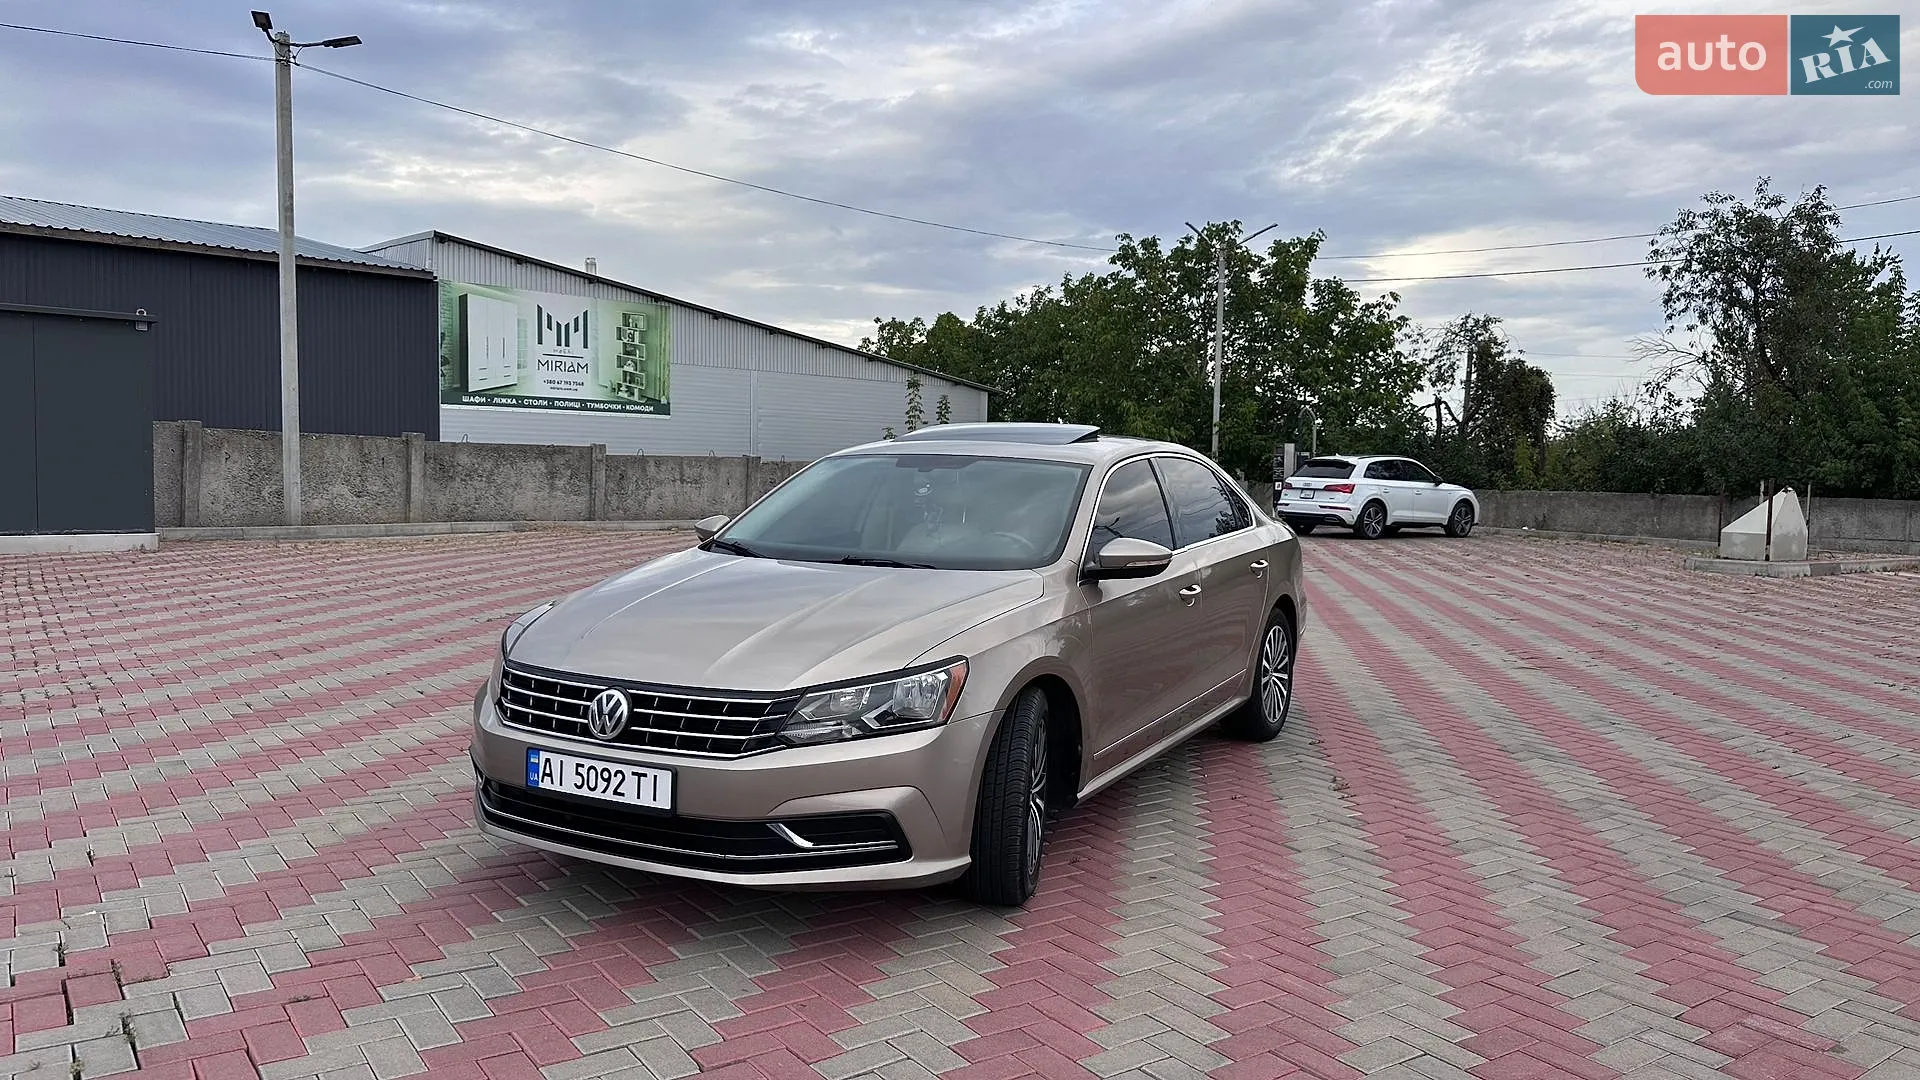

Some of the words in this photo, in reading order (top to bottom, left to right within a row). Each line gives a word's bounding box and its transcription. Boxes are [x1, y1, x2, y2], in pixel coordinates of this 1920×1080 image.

[462, 395, 486, 404] ШАФИ
[493, 397, 518, 405] ЛІЖКА
[523, 398, 548, 407] СТОЛИ
[554, 400, 581, 409] ПОЛИЦІ
[586, 402, 621, 411] ТУМБОЧКИ
[625, 404, 654, 412] КОМОДИ
[529, 771, 539, 781] UA
[541, 757, 564, 787] AI
[573, 763, 626, 797] 5092
[631, 771, 658, 802] TI
